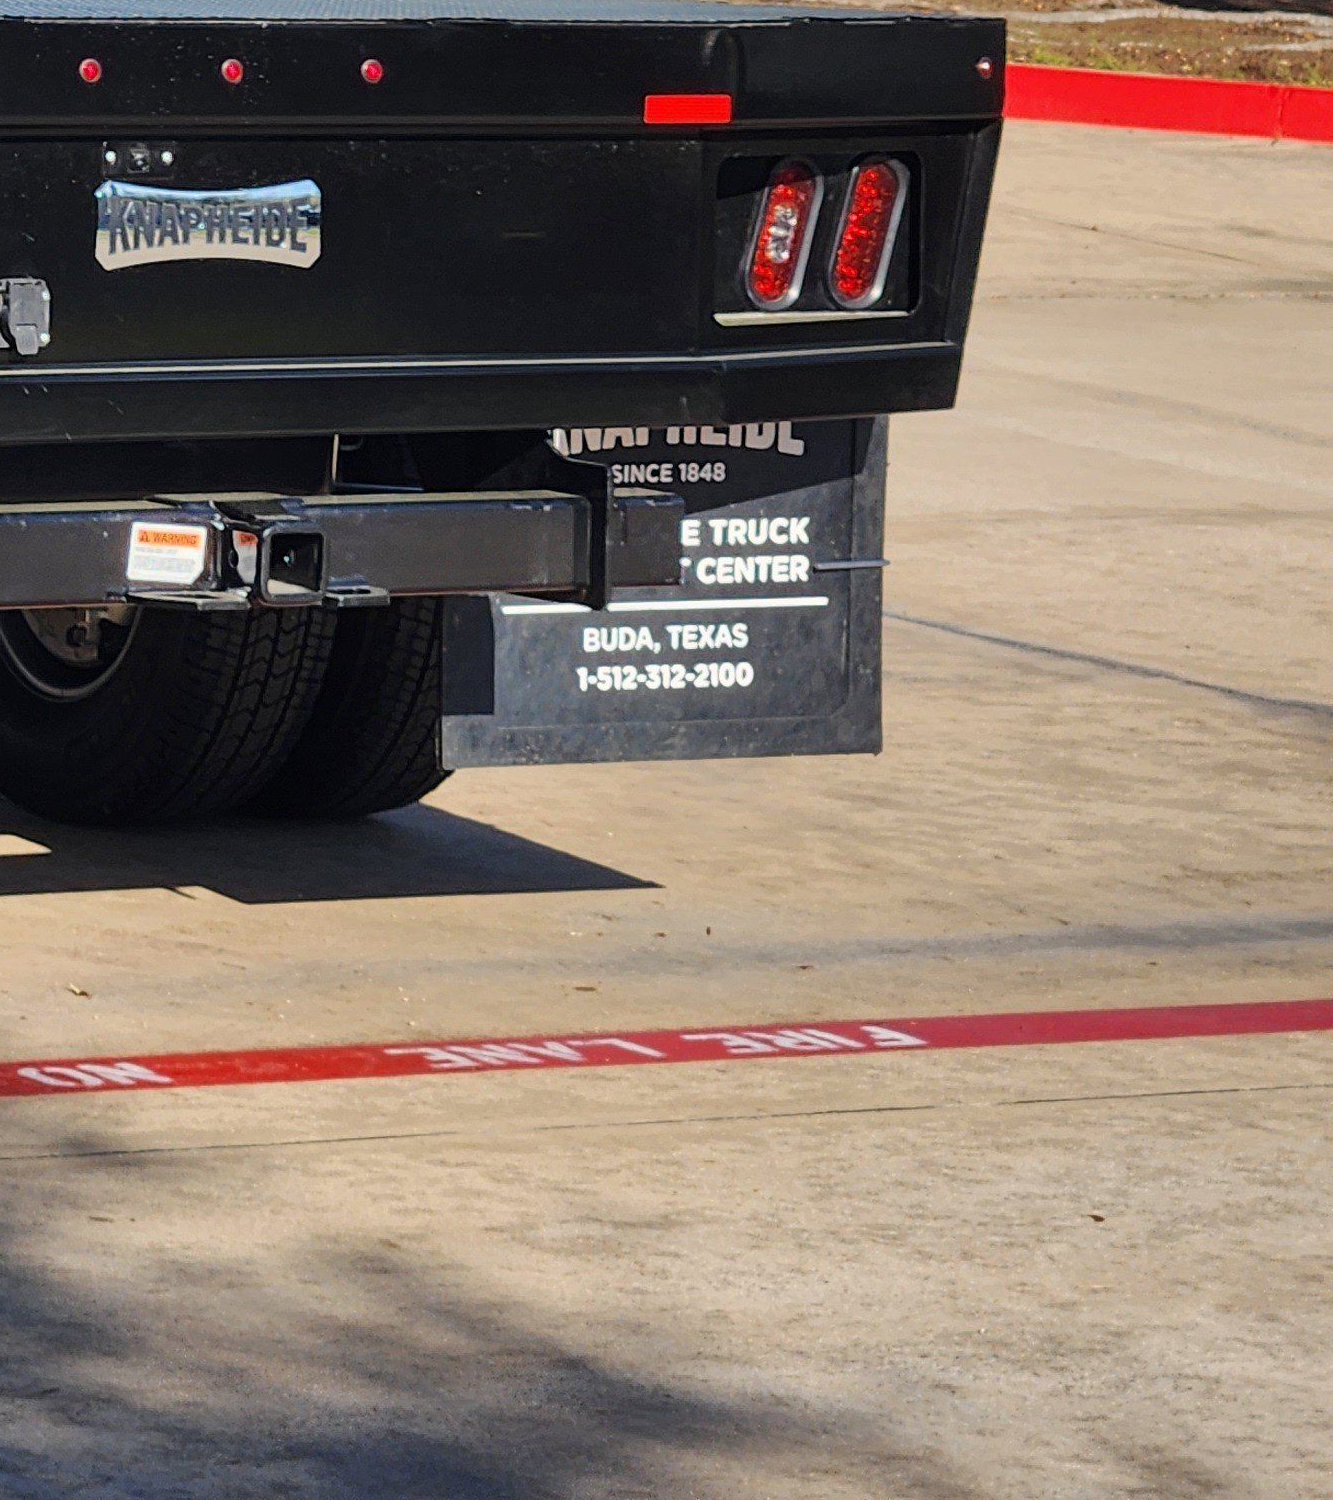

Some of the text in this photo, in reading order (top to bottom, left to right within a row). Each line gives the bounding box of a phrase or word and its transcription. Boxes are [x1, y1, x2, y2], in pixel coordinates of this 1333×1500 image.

[108, 197, 307, 255] KNAPHEIDE
[612, 462, 726, 484] SINCE 1848
[153, 531, 198, 545] WARNING
[708, 516, 811, 546] TRUCK
[696, 554, 810, 585] CENTER
[582, 622, 749, 654] BUDA, TEXAS
[576, 661, 754, 692] 1-512-312-2100
[383, 1037, 667, 1069] LANE
[681, 1025, 928, 1054] FIRE
[16, 1061, 174, 1088] NO
